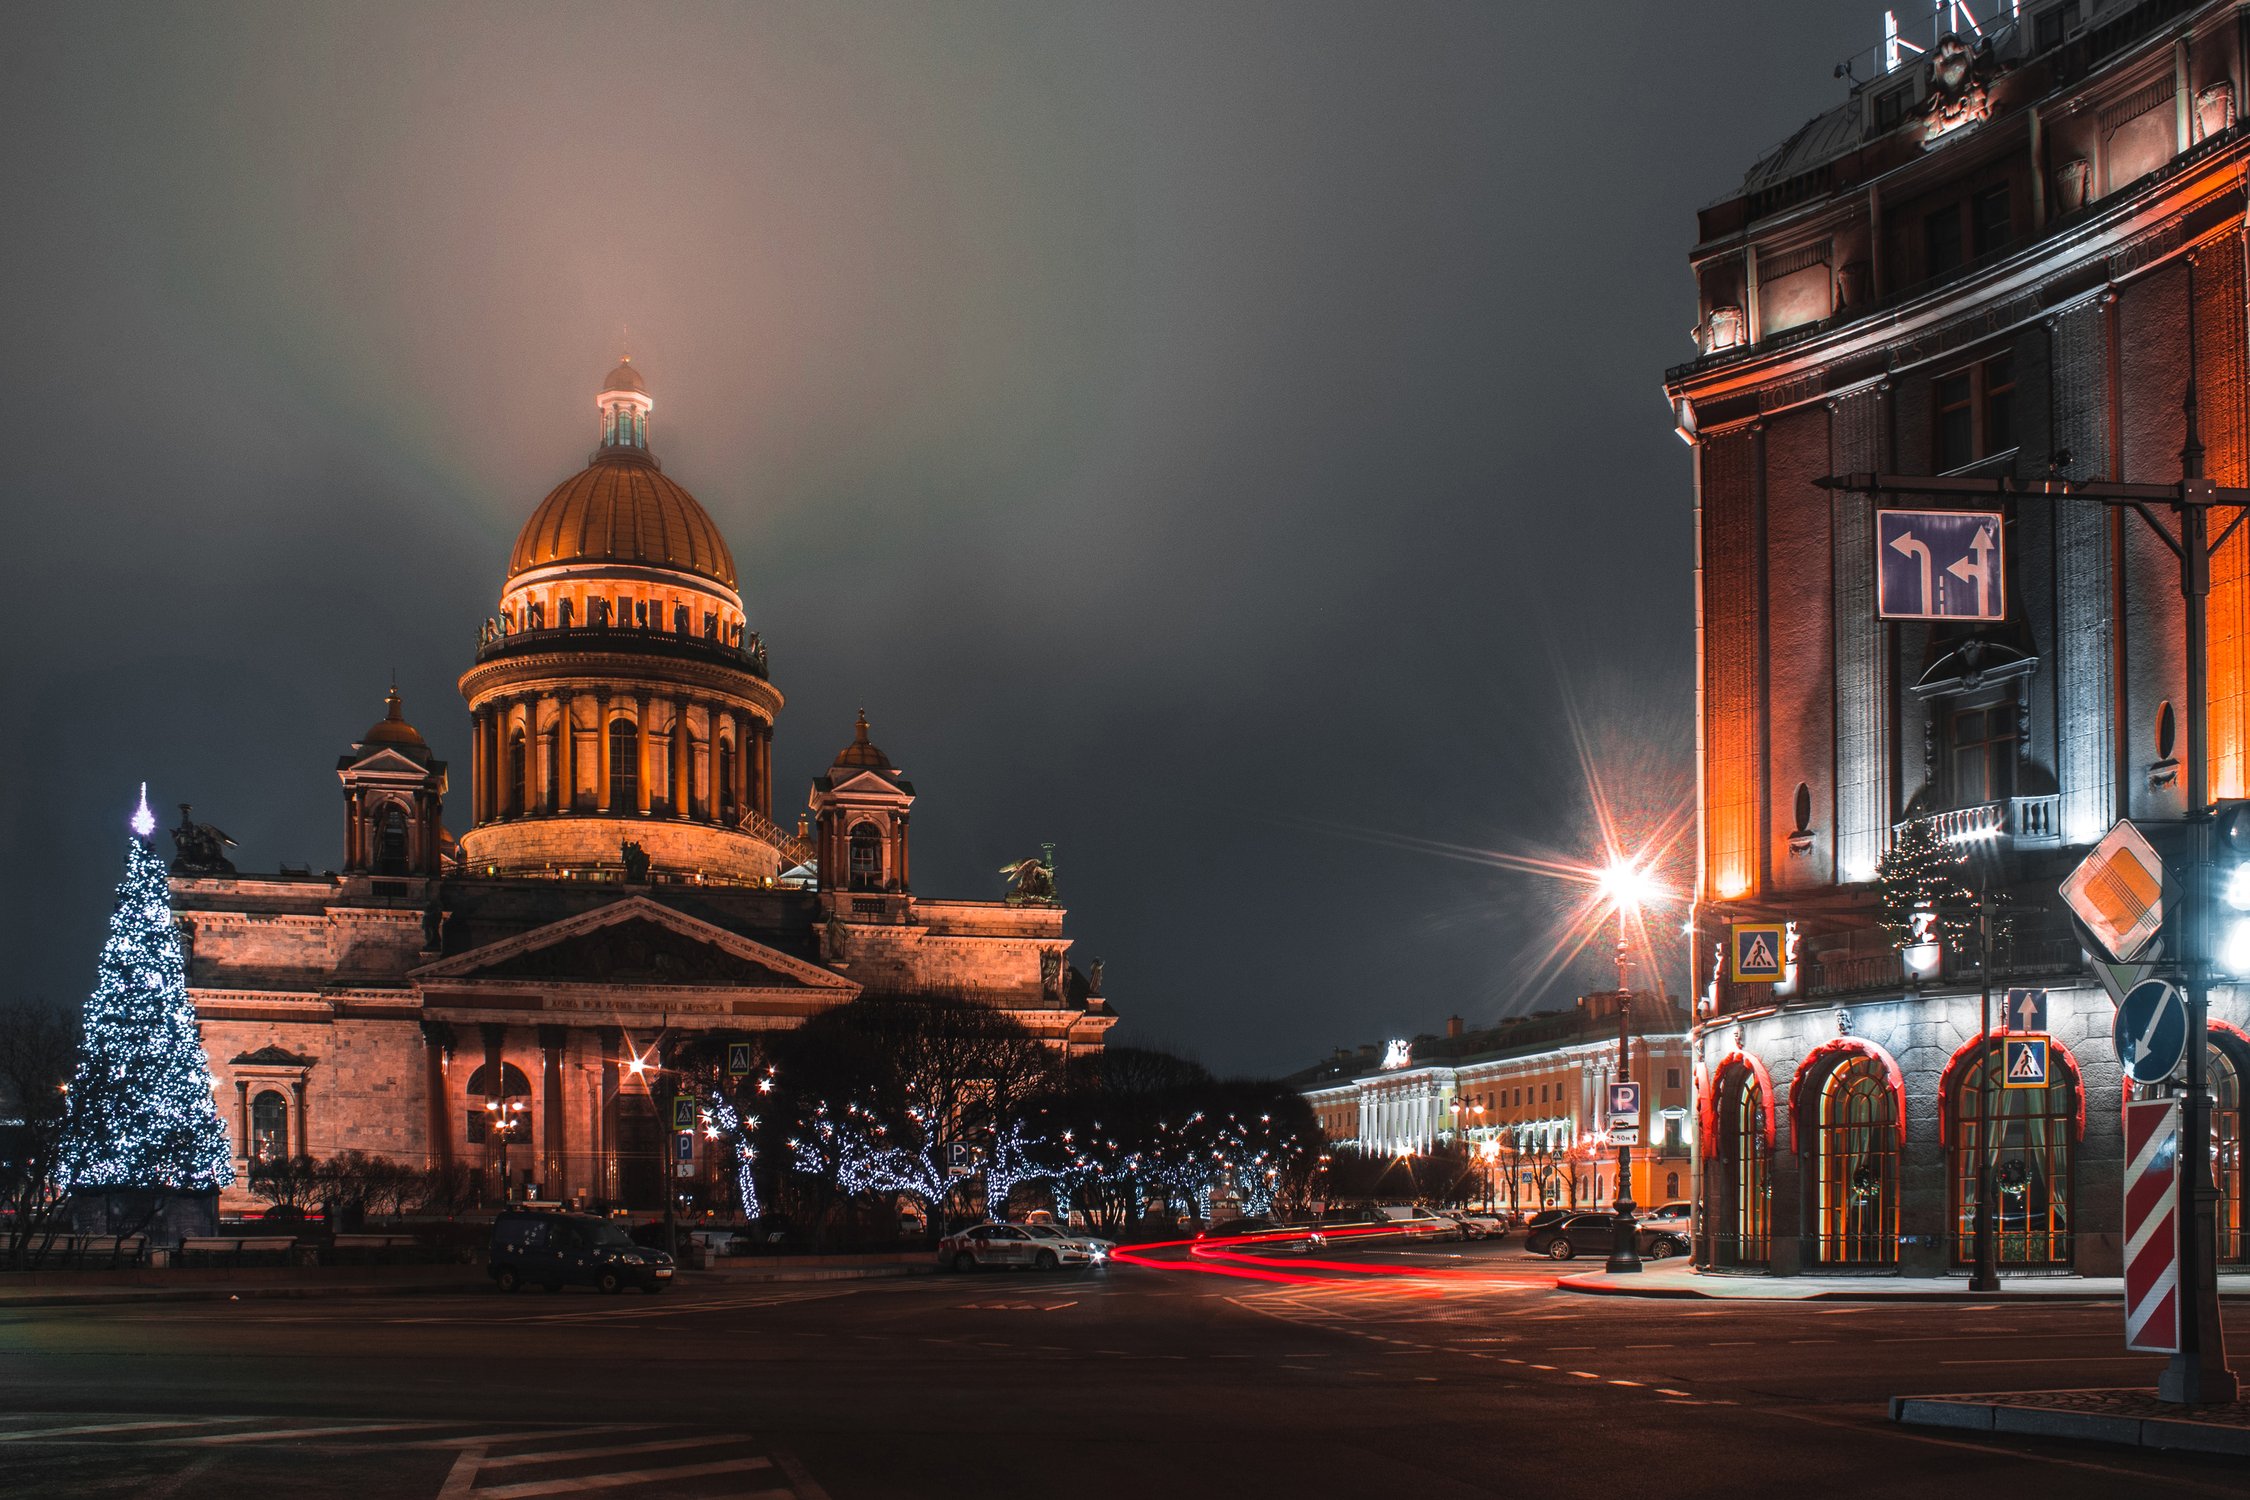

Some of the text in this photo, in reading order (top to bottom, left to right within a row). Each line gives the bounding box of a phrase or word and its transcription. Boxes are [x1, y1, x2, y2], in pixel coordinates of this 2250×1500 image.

[2108, 223, 2185, 281] HOTEL
[1888, 292, 2045, 372] ASTORIA
[1617, 1087, 1634, 1111] P
[680, 1137, 690, 1158] P
[953, 1144, 966, 1161] P
